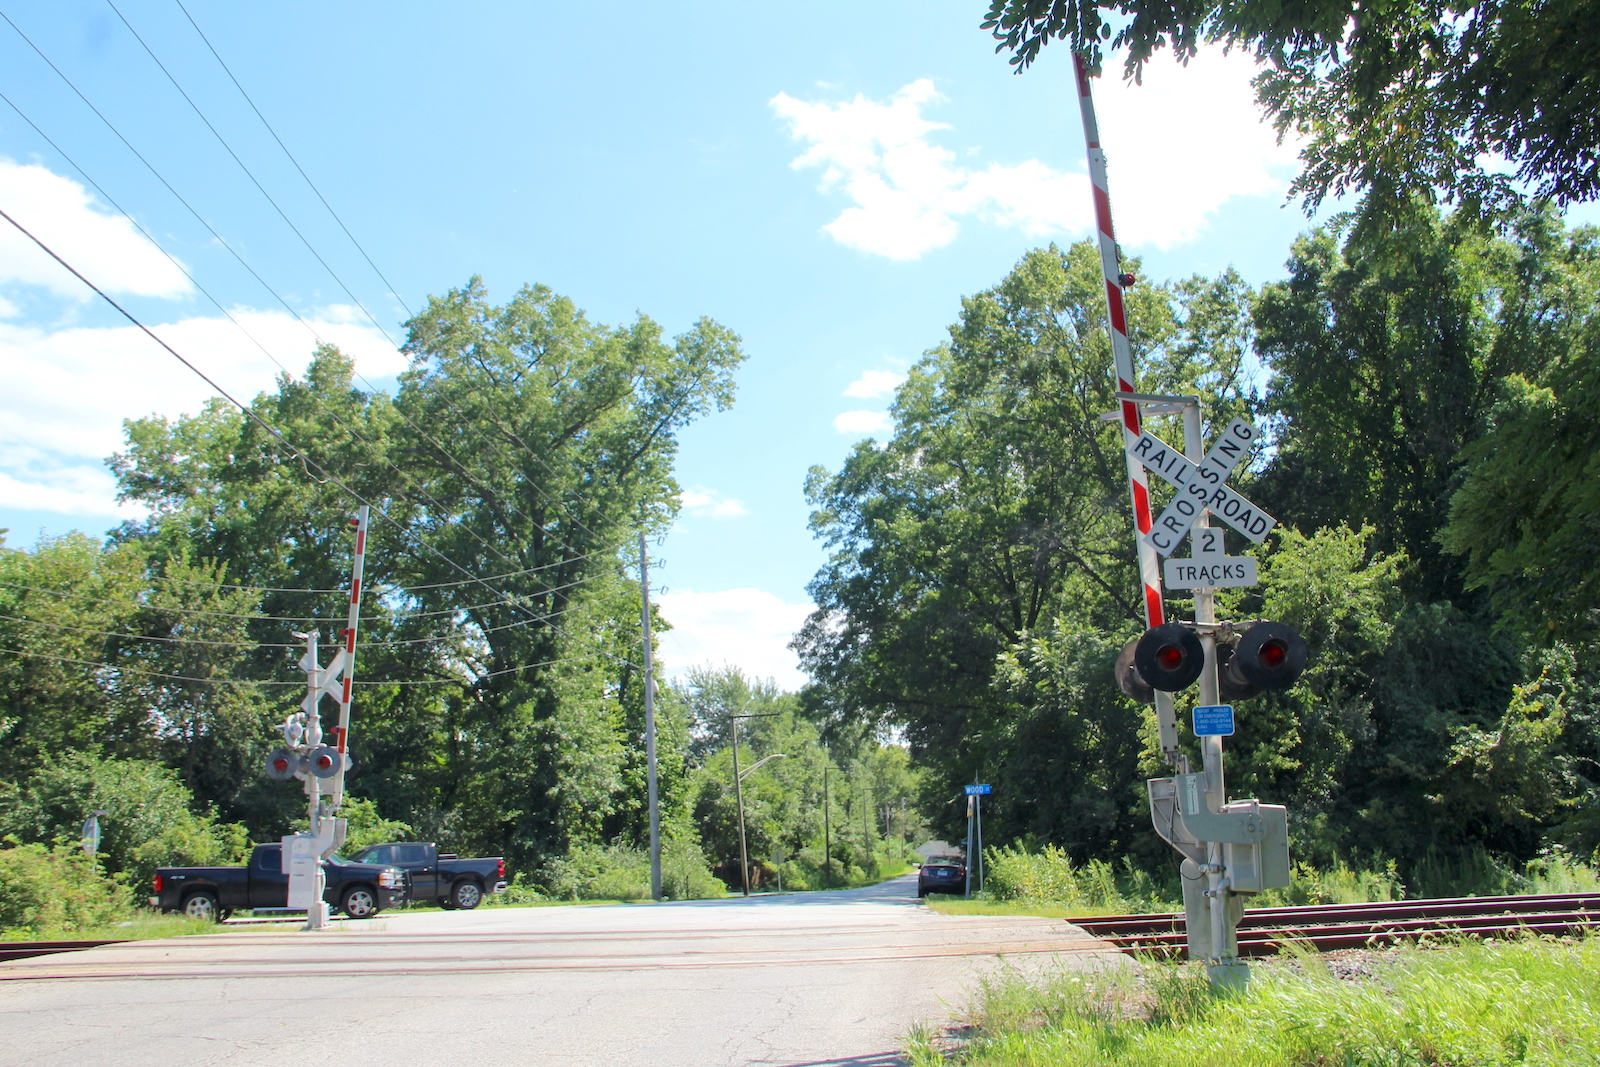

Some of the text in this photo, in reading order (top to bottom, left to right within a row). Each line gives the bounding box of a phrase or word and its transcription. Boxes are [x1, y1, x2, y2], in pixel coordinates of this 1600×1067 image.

[1134, 436, 1267, 536] RAIL ROAD
[1151, 423, 1253, 549] CROSSING
[1202, 533, 1216, 553] 2
[1176, 564, 1245, 581] TRACKS
[966, 786, 984, 794] WOOD
